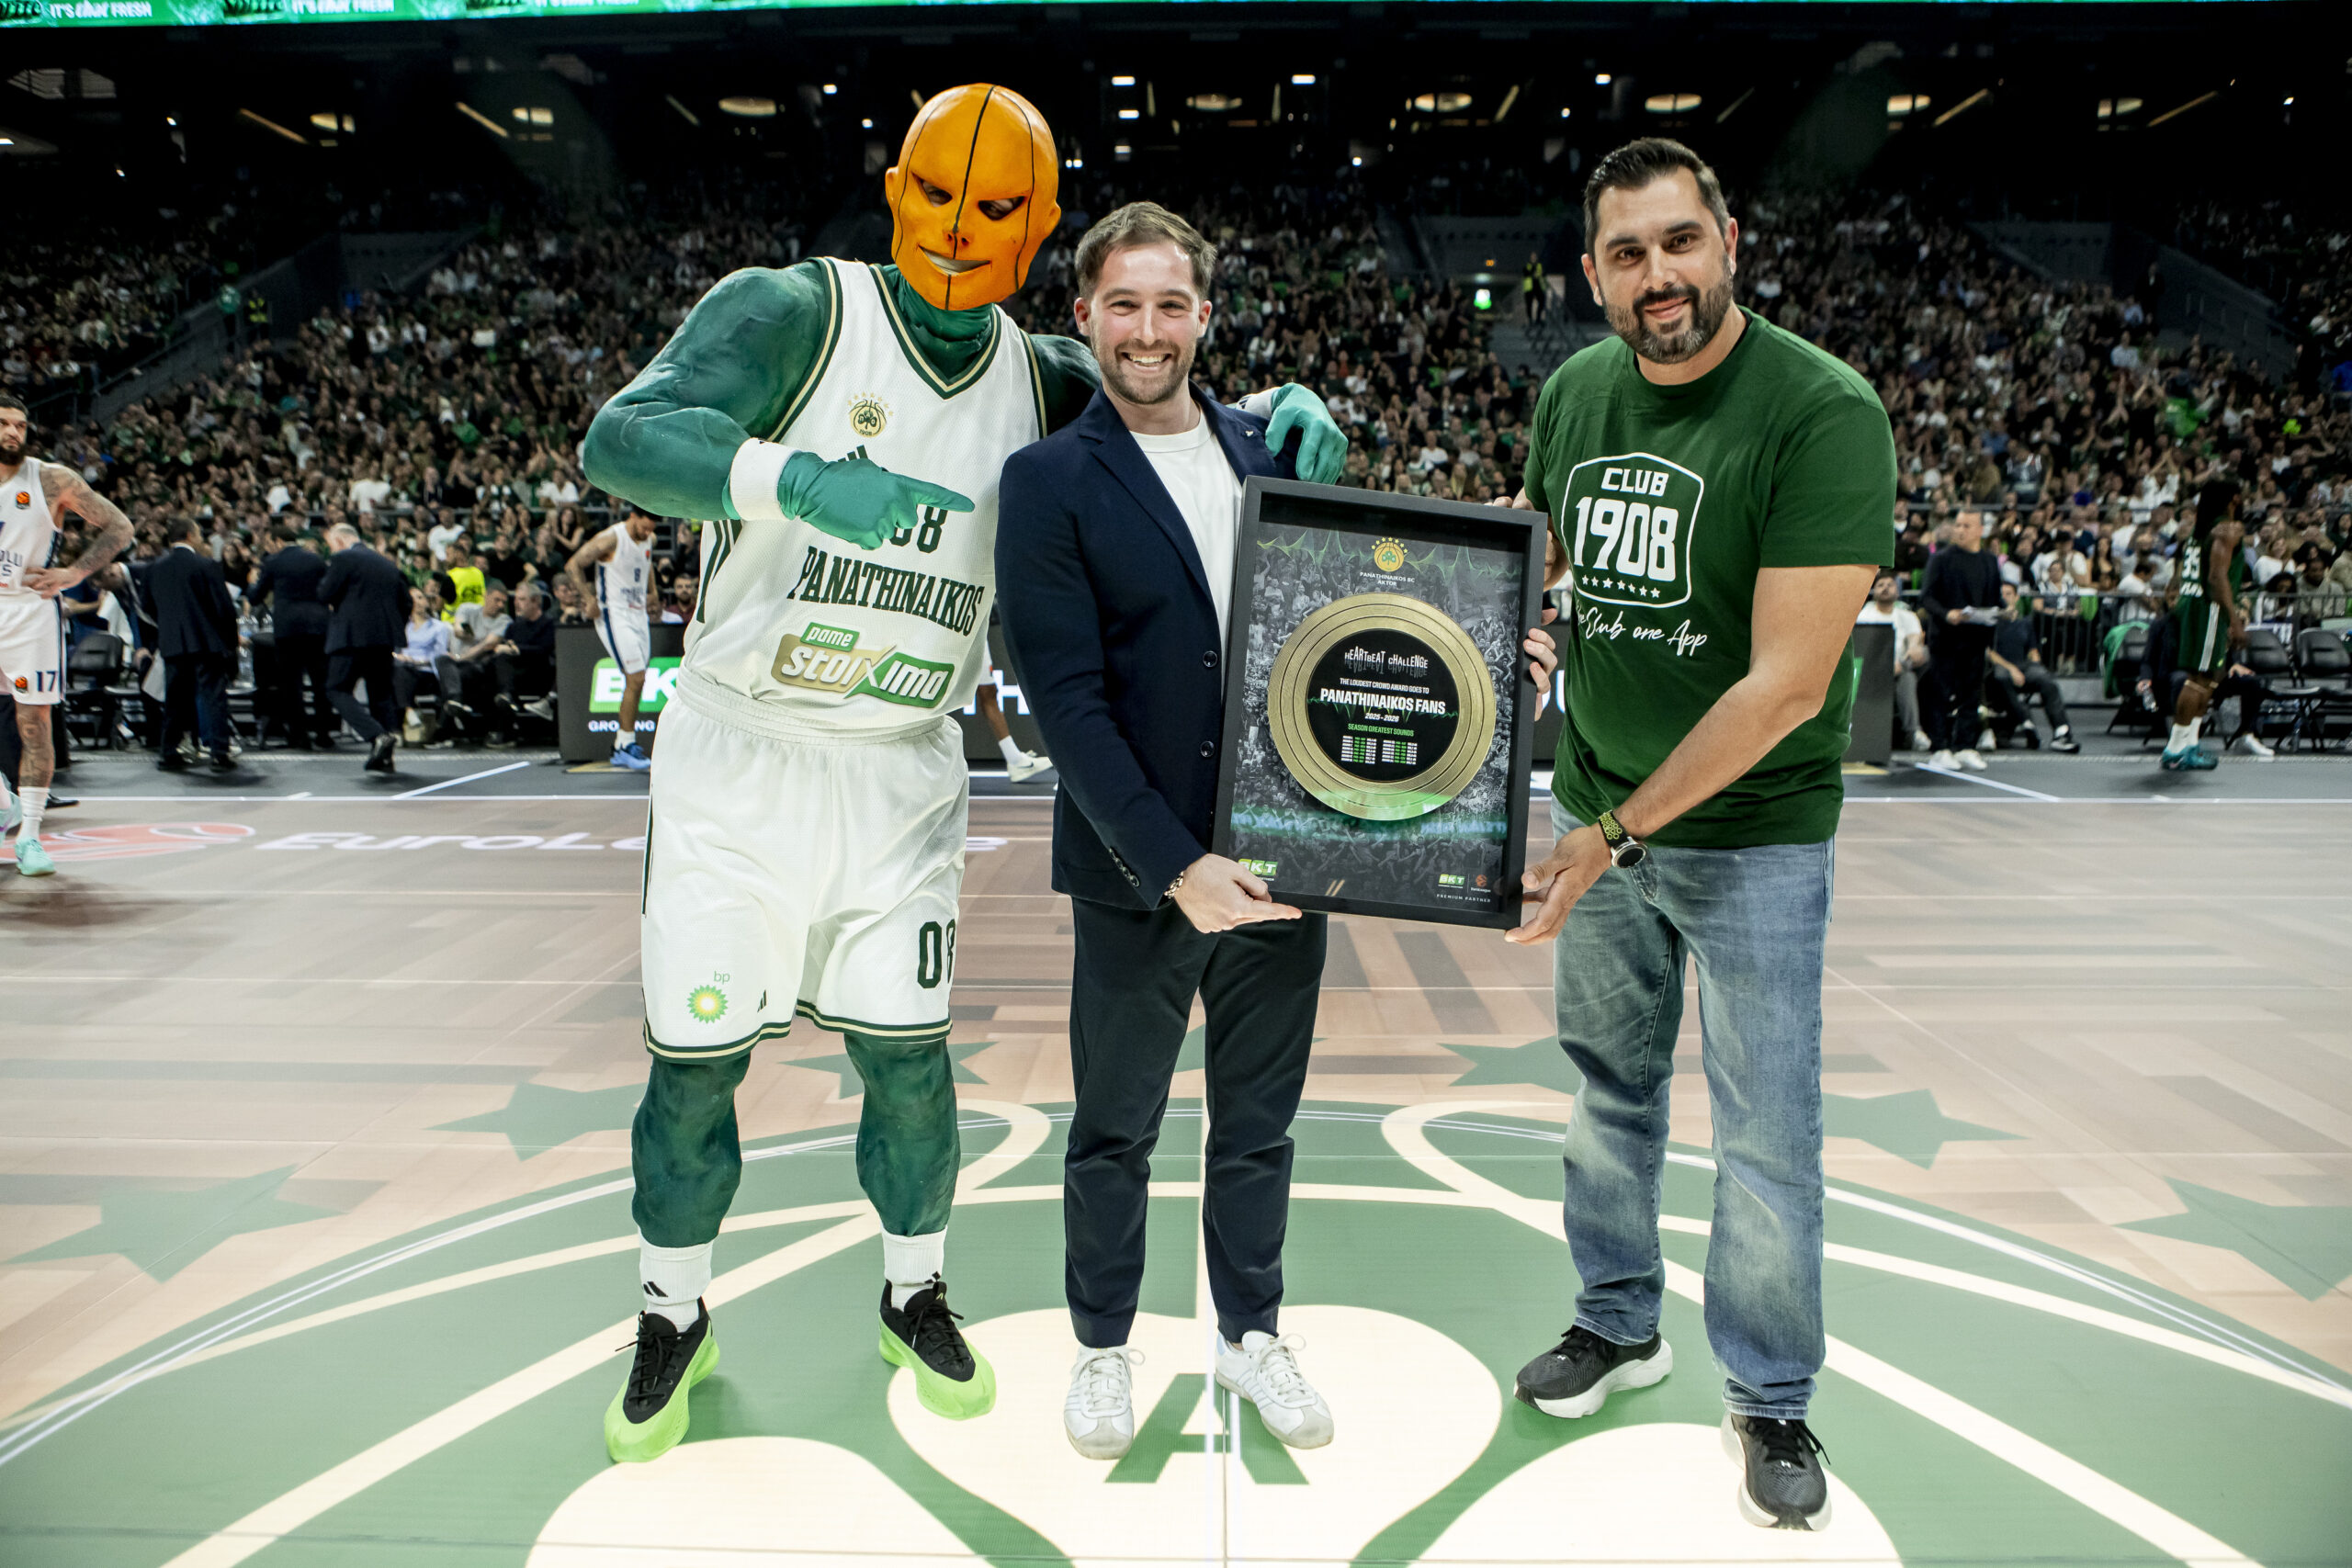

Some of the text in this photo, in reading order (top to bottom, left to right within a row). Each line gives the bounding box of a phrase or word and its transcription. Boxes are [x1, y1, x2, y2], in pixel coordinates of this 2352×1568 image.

[1600, 467, 1669, 497] CLUB
[1574, 496, 1679, 582] 1908
[1360, 571, 1407, 582] PANATHINAIKOS
[786, 545, 986, 637] PANATHINAIKOS
[806, 626, 854, 648] pame
[1633, 626, 1665, 640] one
[1667, 618, 1708, 657] App
[35, 670, 58, 693] 17
[1340, 677, 1350, 685] THE
[1350, 679, 1372, 688] LOUDEST
[1372, 682, 1391, 691] CROWD
[1390, 683, 1408, 693] AWARD
[1408, 685, 1422, 694] GOES
[1319, 687, 1446, 715] PANATHINAIKOS FANS
[588, 719, 657, 733] GRONG
[1348, 723, 1415, 738] SEASON GREATEST SOUNDS
[713, 970, 730, 985] bp
